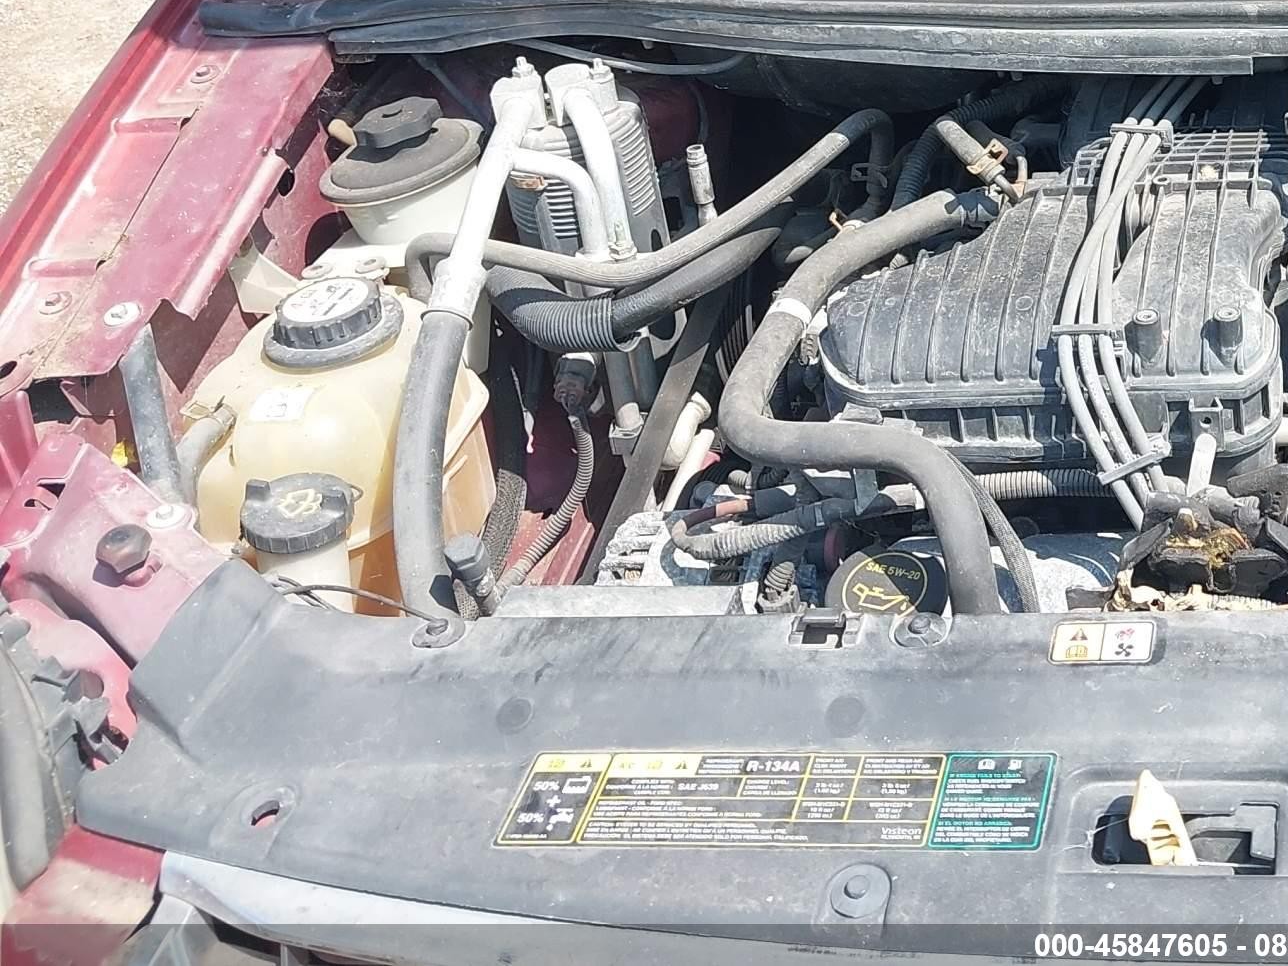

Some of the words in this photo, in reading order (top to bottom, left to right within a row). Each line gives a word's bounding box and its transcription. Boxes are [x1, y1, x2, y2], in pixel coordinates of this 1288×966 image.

[866, 562, 887, 574] SAE
[887, 566, 921, 580] 5W-20
[745, 760, 800, 772] R-134A
[533, 781, 560, 791] 50%
[677, 783, 697, 791] SAE
[697, 783, 719, 791] J639
[517, 812, 544, 823] 50%
[881, 827, 922, 835] Visteon
